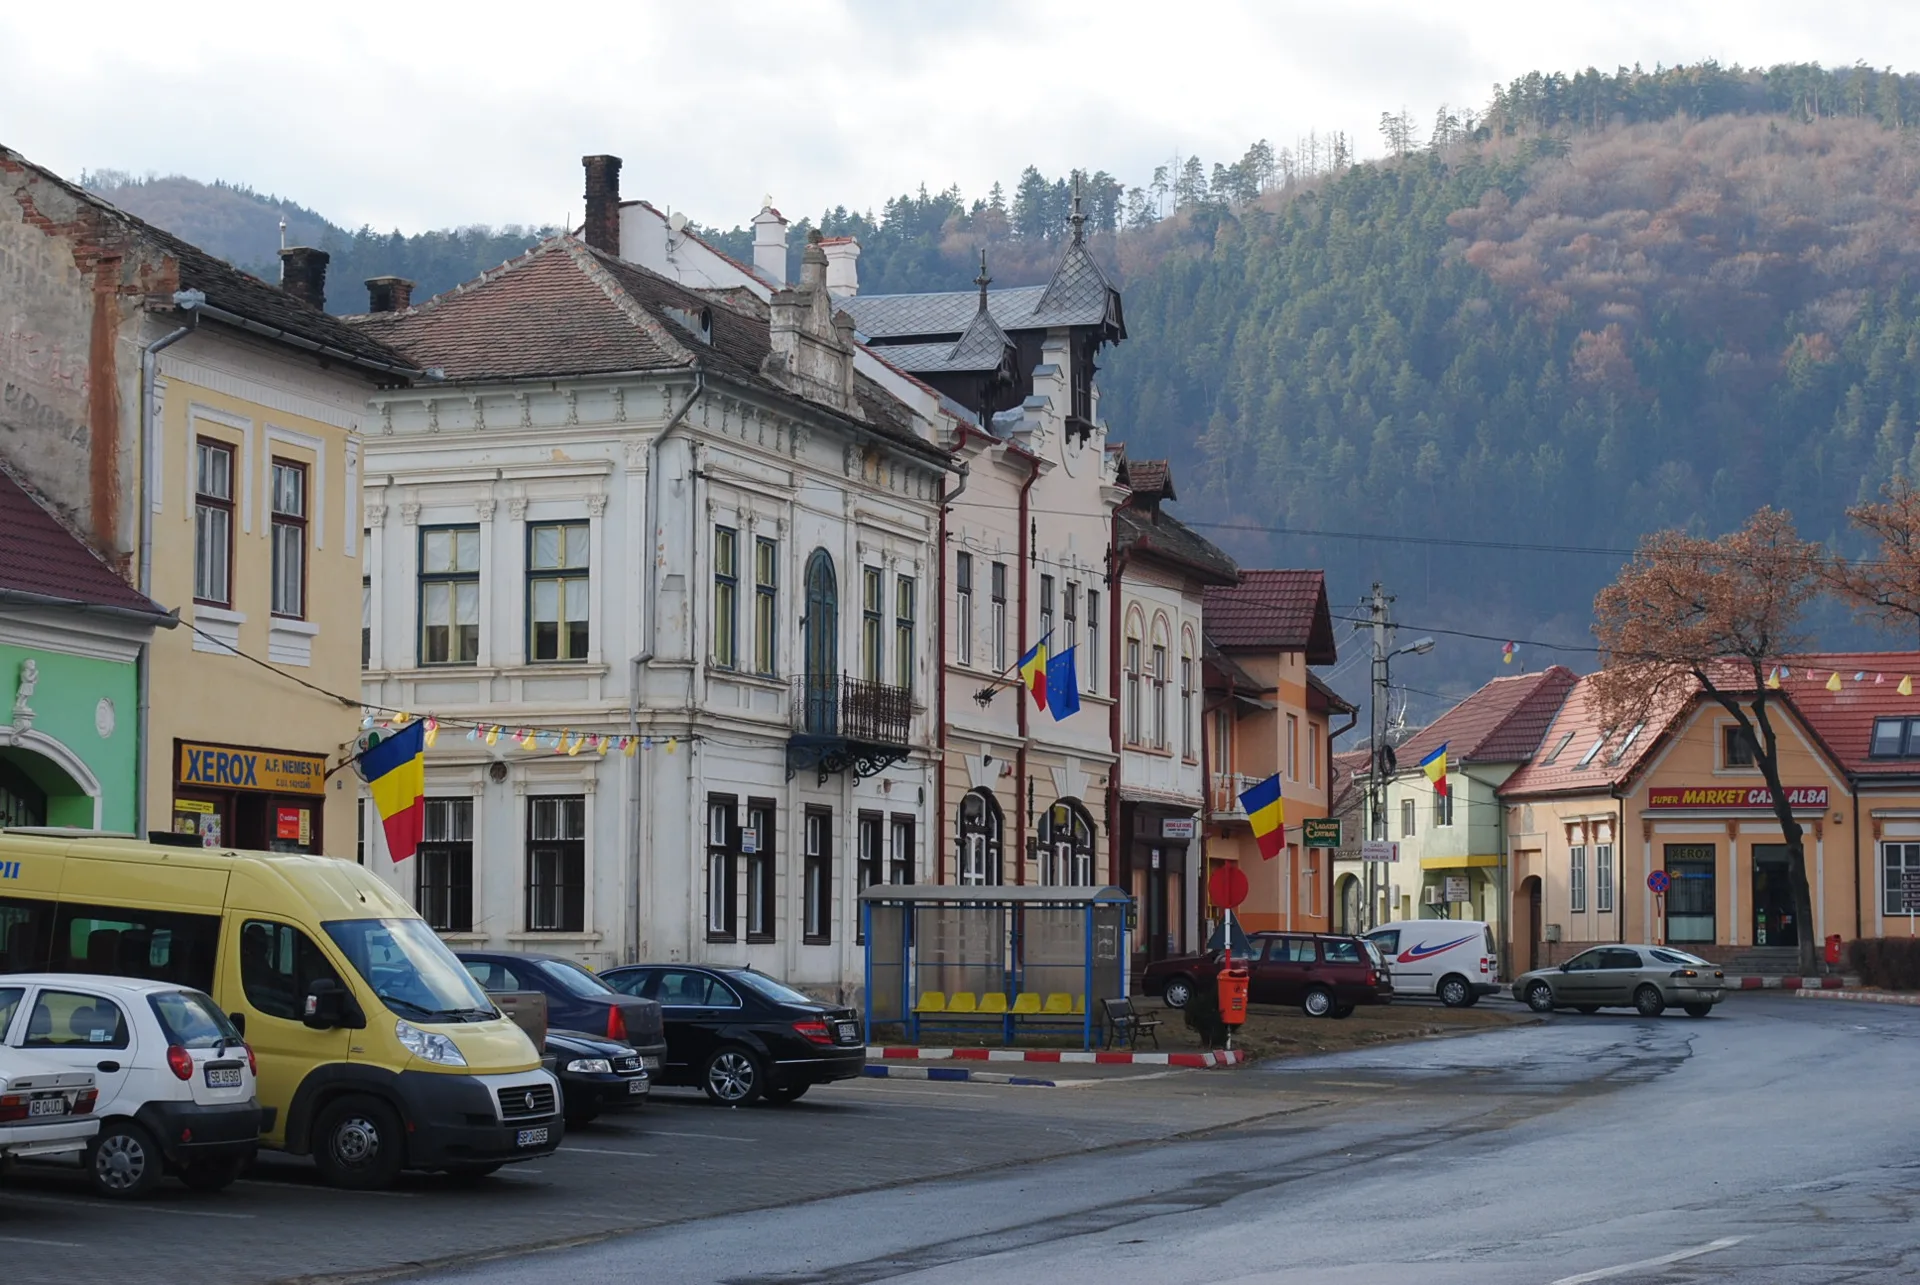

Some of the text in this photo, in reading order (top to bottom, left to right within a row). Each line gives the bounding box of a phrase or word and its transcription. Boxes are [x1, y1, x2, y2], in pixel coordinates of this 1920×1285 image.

[186, 749, 257, 786] XEROX
[265, 758, 321, 776] A.F. NEMES V.
[1652, 789, 1826, 804] SUPER MARKET CAS ALBA
[1672, 849, 1712, 858] XEROX
